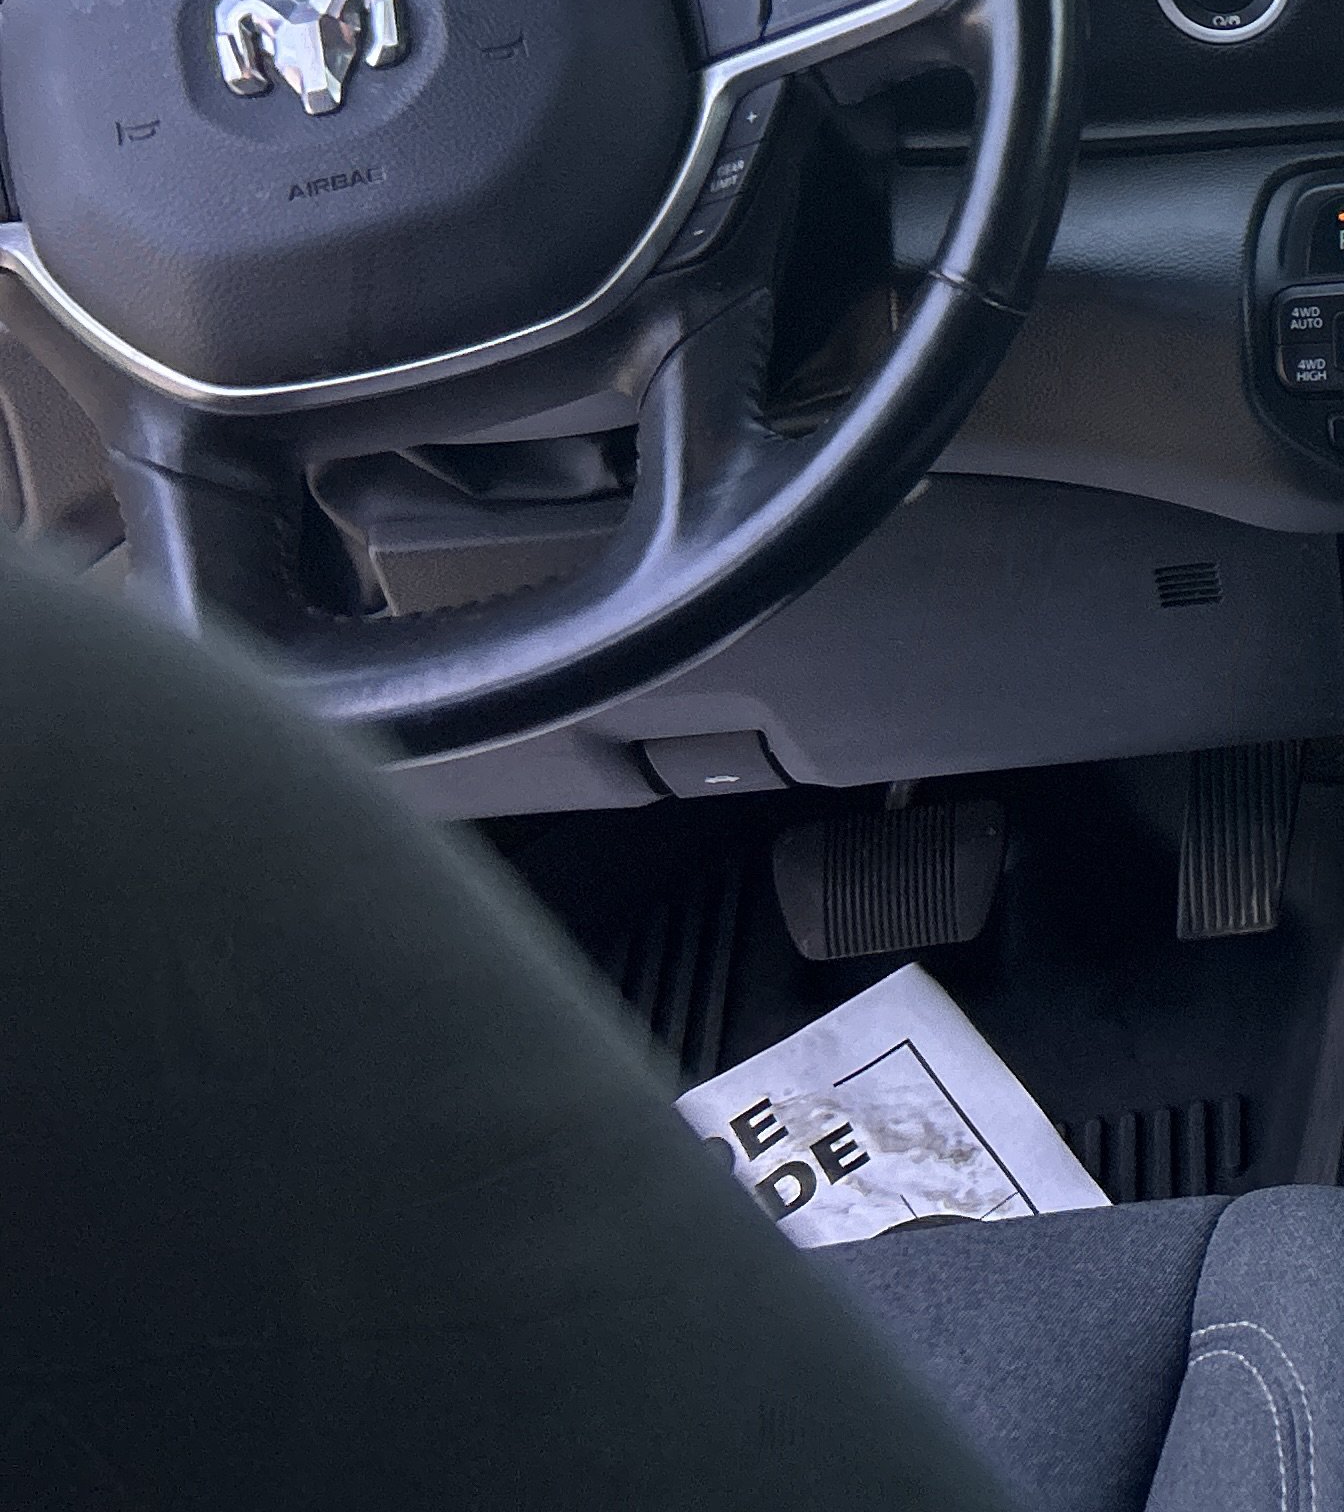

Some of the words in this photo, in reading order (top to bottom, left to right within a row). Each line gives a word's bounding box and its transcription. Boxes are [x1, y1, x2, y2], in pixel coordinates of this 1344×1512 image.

[1291, 306, 1321, 318] 4WD
[1290, 317, 1323, 329] AUTO
[1297, 358, 1326, 370] 4WD
[1296, 369, 1328, 382] HIGH
